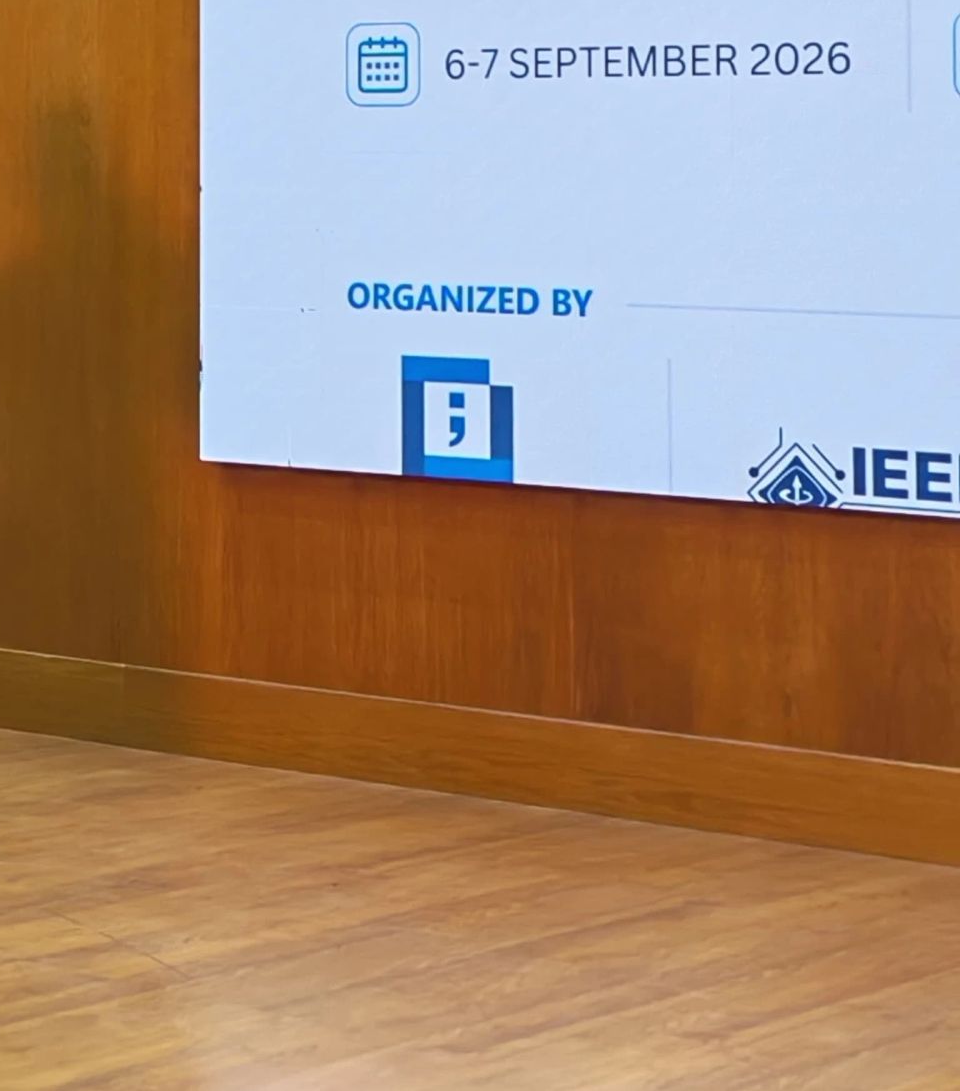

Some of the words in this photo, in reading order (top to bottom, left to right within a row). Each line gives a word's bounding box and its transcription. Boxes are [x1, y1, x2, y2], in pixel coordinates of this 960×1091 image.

[445, 48, 499, 81] 6-7
[509, 43, 738, 79] SEPTEMBER
[750, 41, 851, 77] 2026
[347, 281, 540, 316] ORGANIZED
[552, 288, 593, 318] BY
[852, 446, 960, 503] IEE
